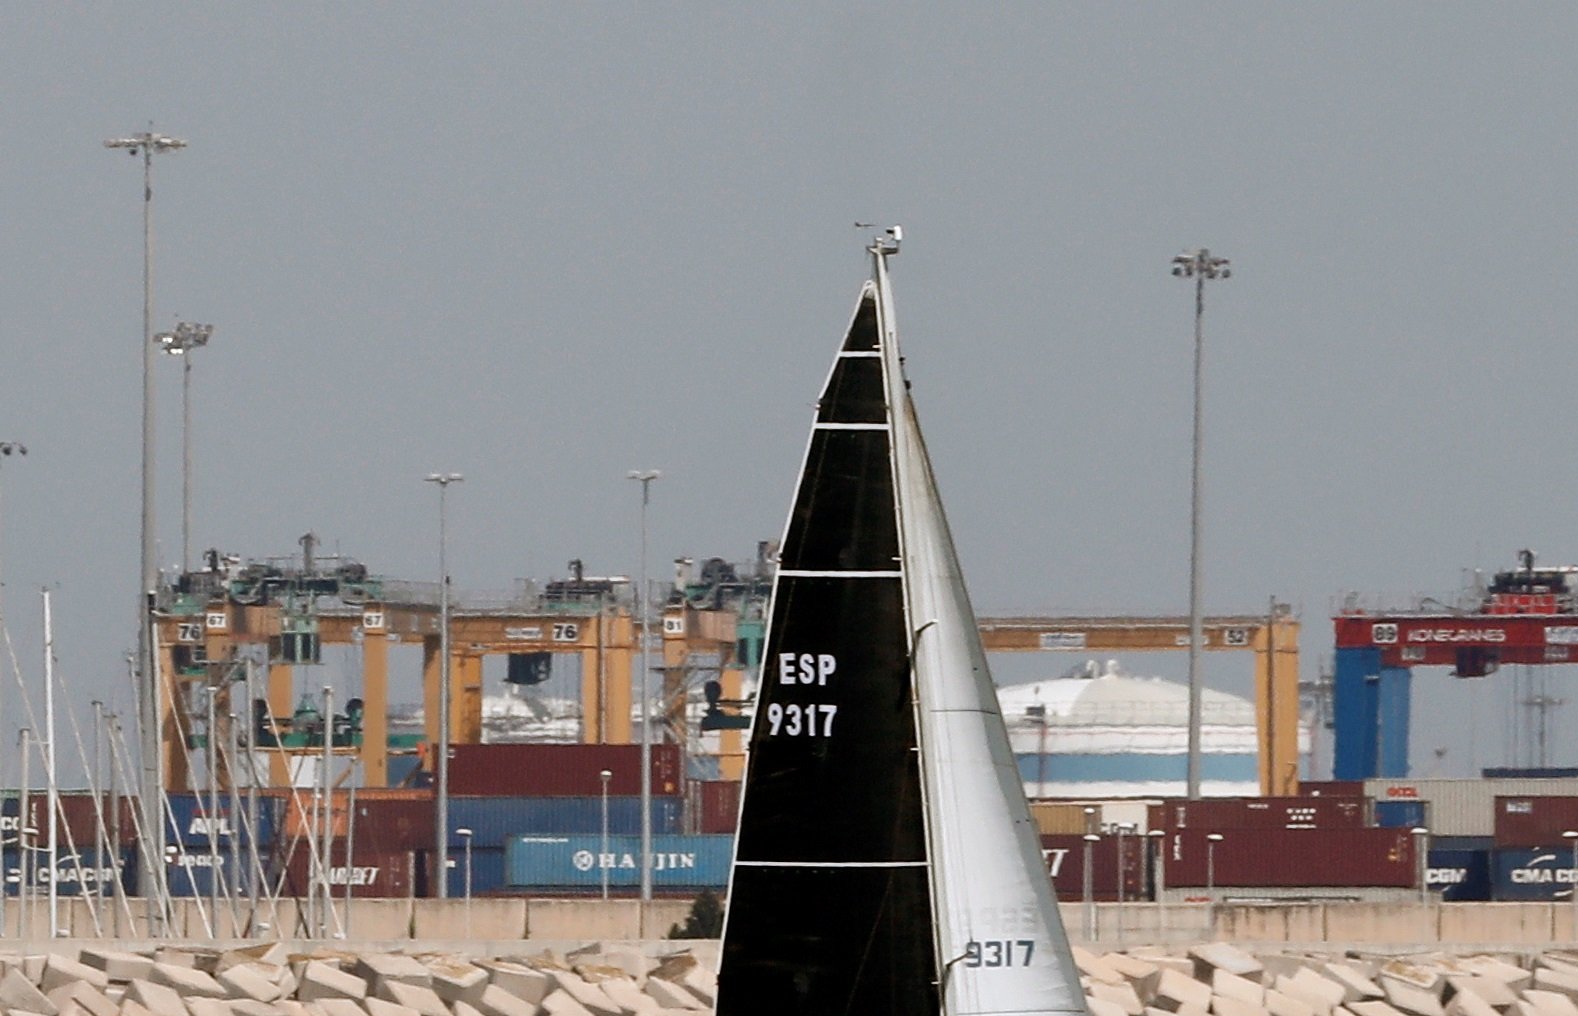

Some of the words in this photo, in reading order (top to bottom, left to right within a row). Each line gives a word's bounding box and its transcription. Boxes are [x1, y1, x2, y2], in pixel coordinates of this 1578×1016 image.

[208, 614, 225, 627] 67
[364, 614, 382, 627] 67
[180, 624, 200, 639] 76
[553, 624, 576, 639] 76
[1227, 629, 1245, 644] 52
[779, 652, 837, 686] ESP
[767, 702, 838, 737] 9317
[598, 852, 696, 869] HAJIN
[1426, 867, 1467, 884] CGM
[1511, 868, 1553, 883] CMA
[966, 940, 1035, 968] 9317
